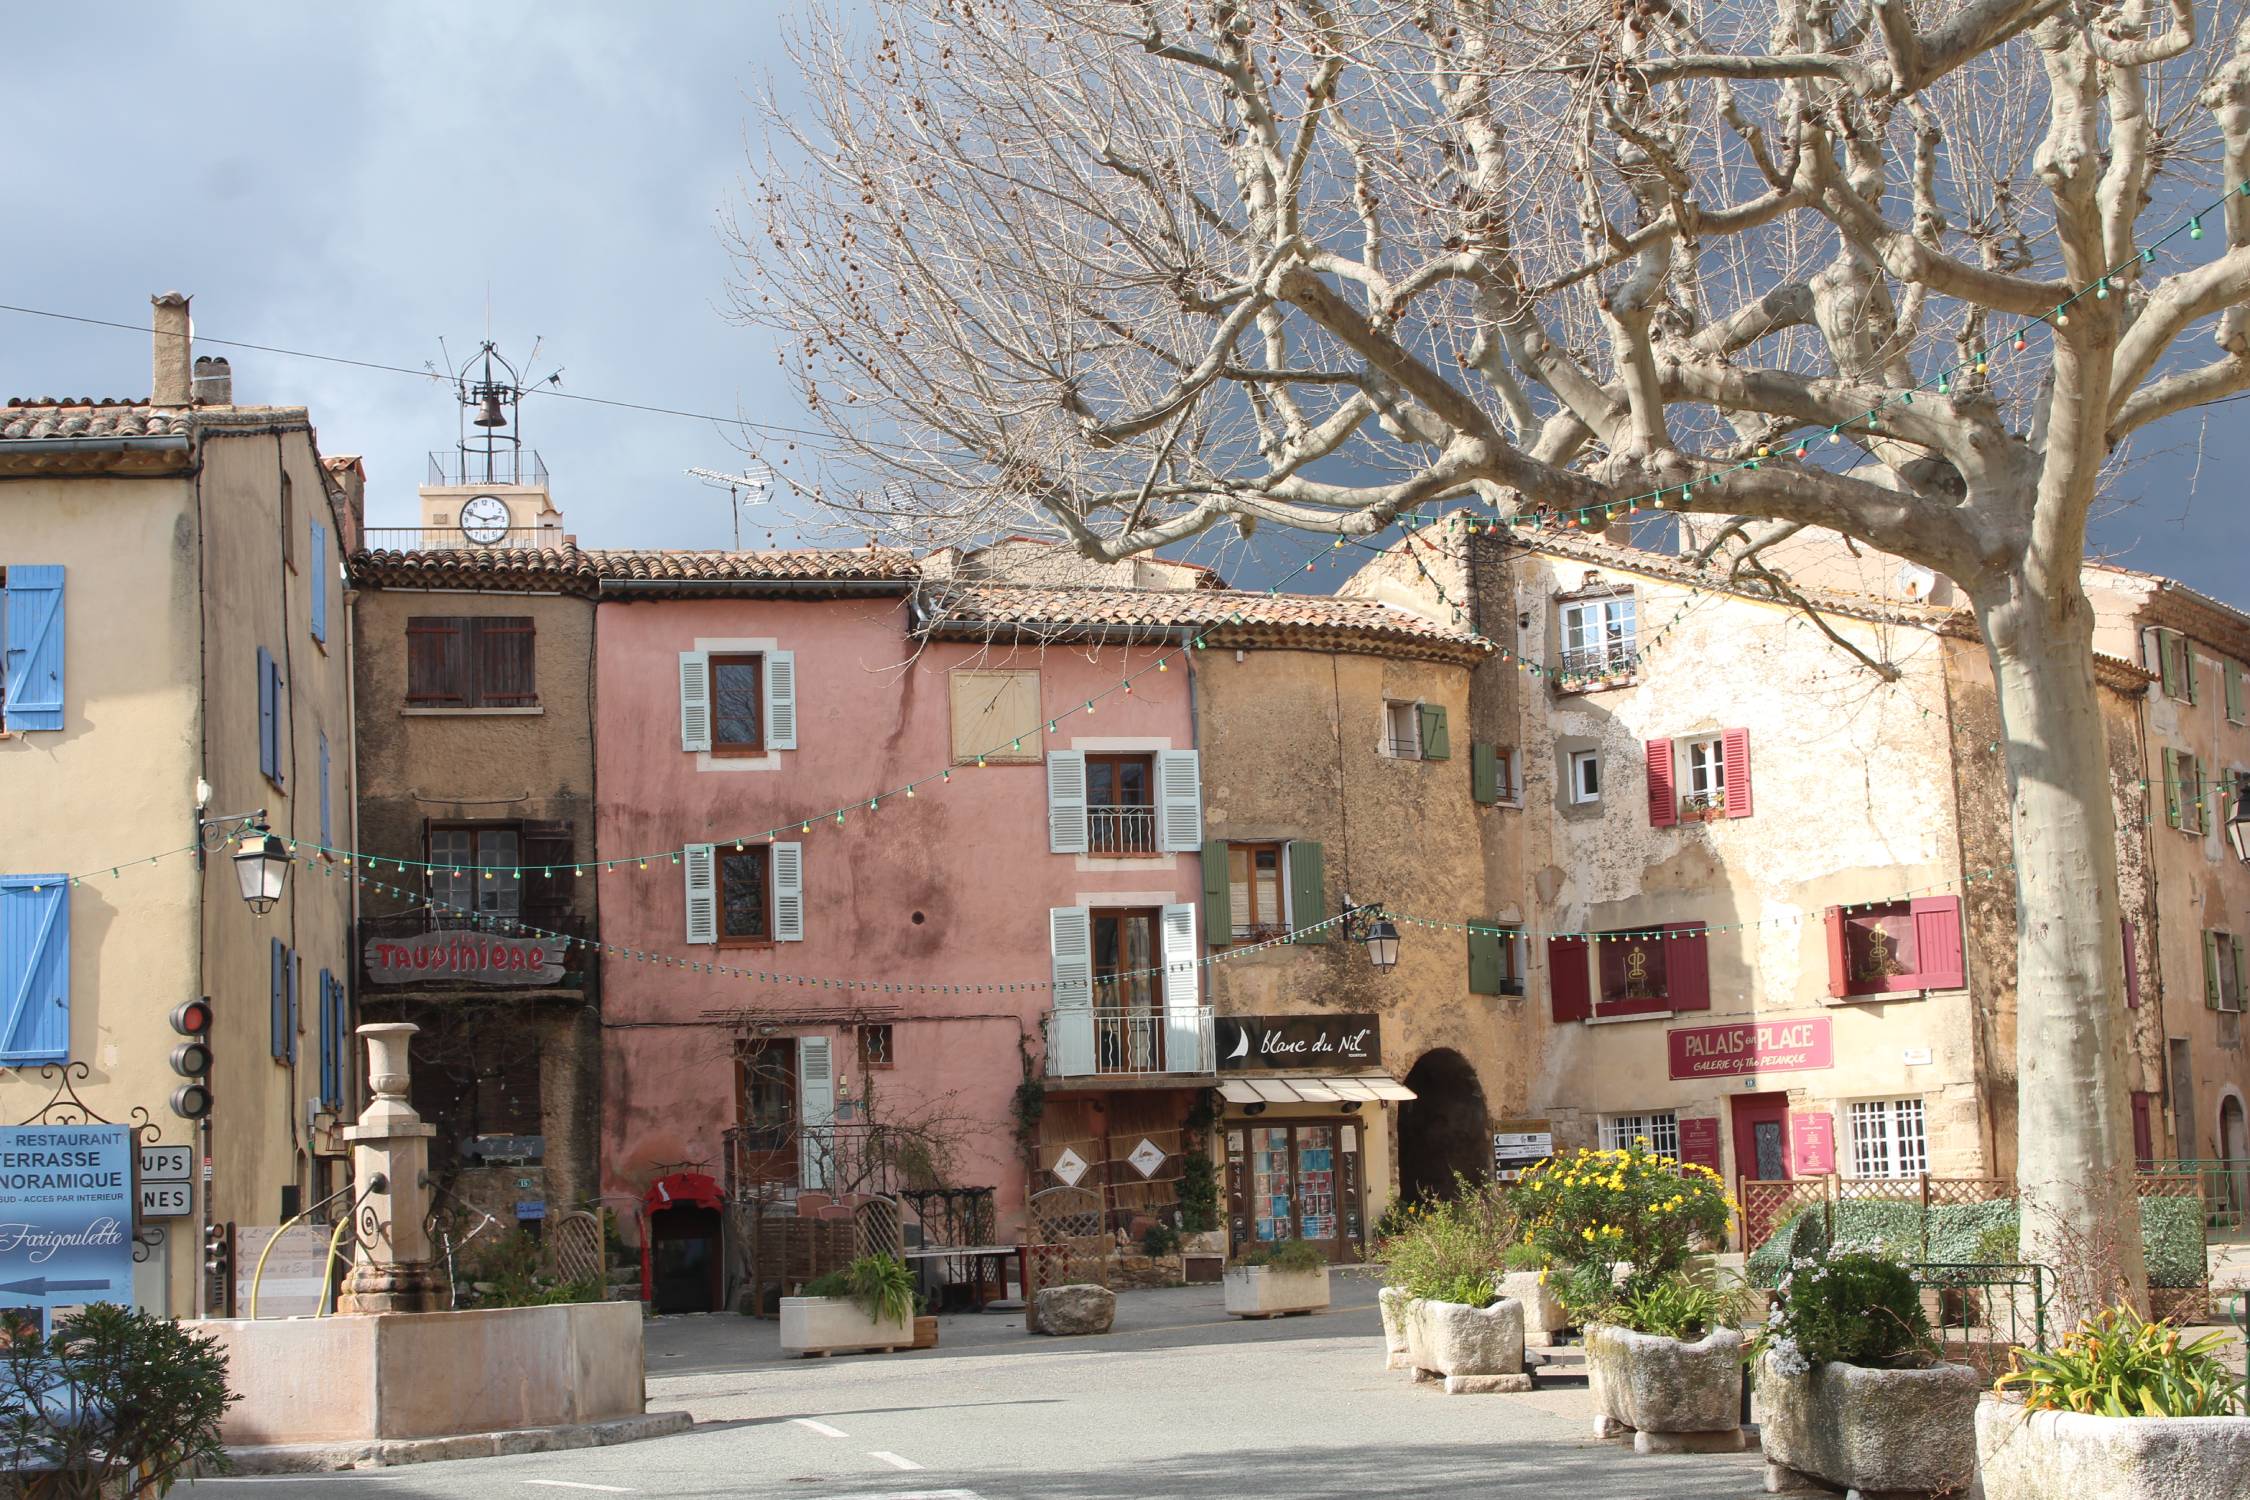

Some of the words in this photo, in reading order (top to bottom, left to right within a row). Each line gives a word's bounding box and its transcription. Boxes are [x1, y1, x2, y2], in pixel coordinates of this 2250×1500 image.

[1311, 1032, 1333, 1053] du
[1685, 1030, 1744, 1057] PALAIS
[1757, 1024, 1814, 1051] PLACE
[1693, 1058, 1731, 1071] GALERIE
[16, 1133, 122, 1147] RESTAURANT
[0, 1151, 100, 1168] ERRASSE
[142, 1155, 183, 1172] UPS
[58, 1194, 74, 1202] PAR
[77, 1192, 124, 1202] INTERIEUR
[144, 1191, 184, 1207] NES
